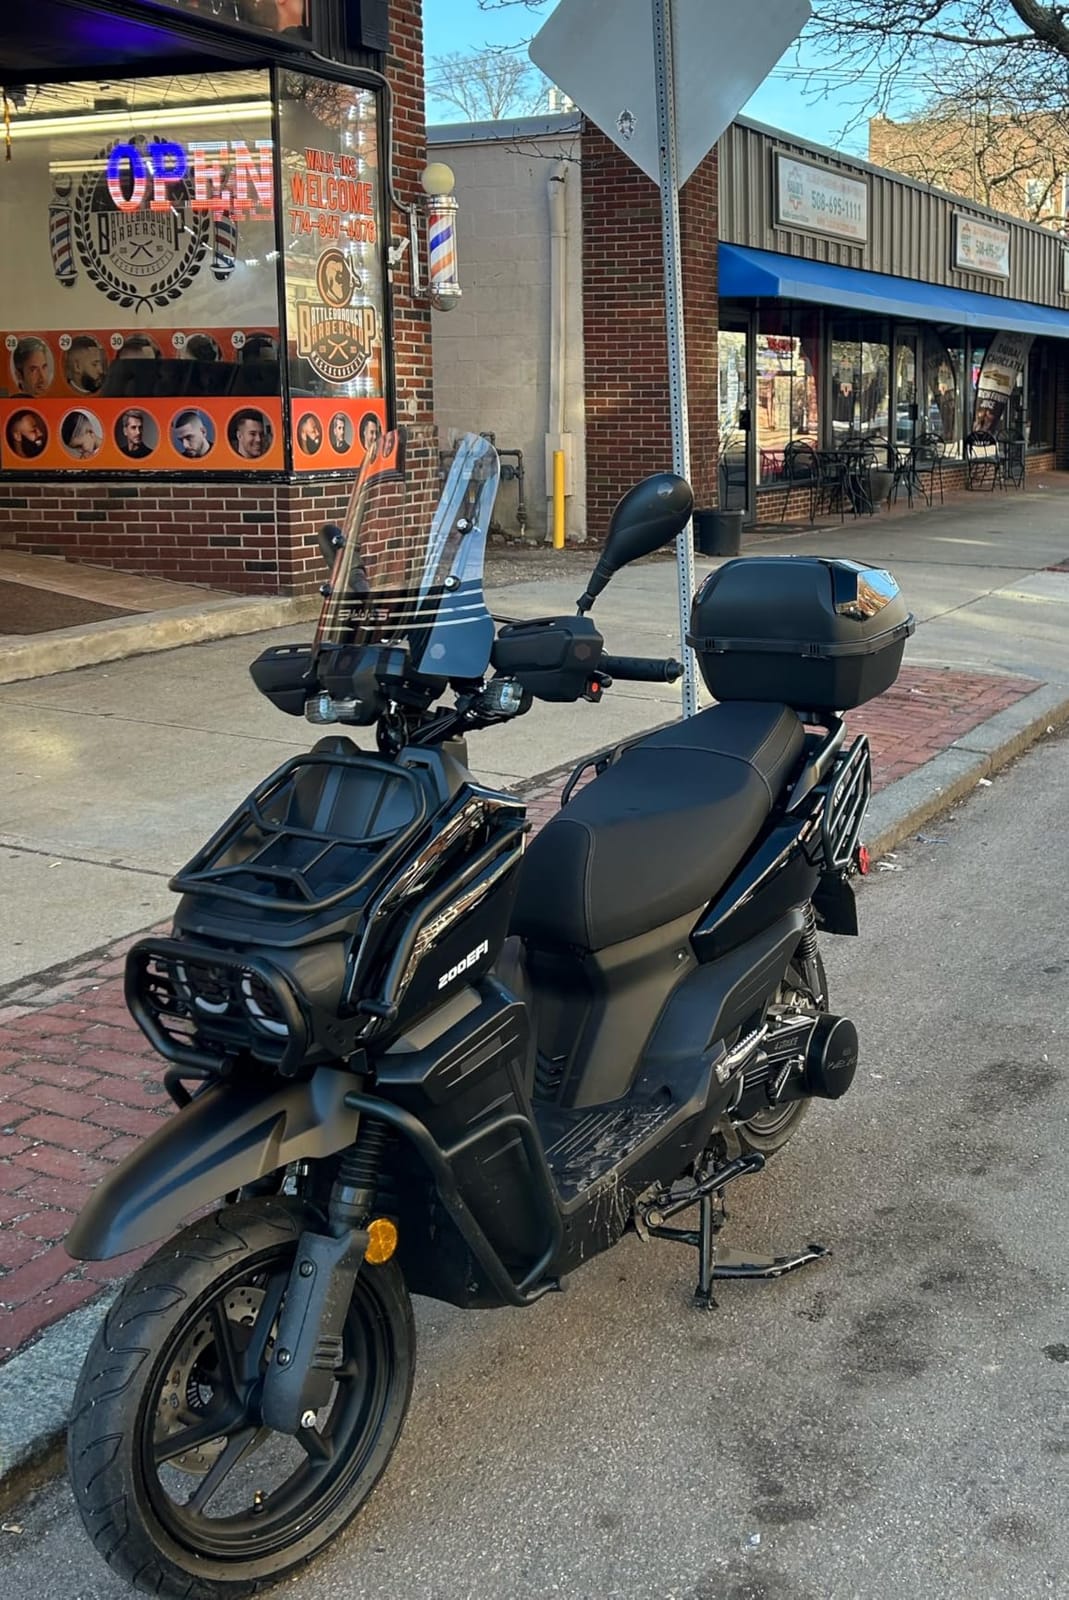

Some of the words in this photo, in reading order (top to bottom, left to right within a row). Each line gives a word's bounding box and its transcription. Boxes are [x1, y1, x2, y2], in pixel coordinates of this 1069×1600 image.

[107, 139, 273, 213] OPEN
[304, 147, 357, 179] WALK-INS
[290, 171, 373, 216] WELCOME
[111, 337, 123, 346] 30
[174, 336, 185, 346] 33
[233, 335, 244, 345] 34
[438, 939, 489, 990] 200EFI
